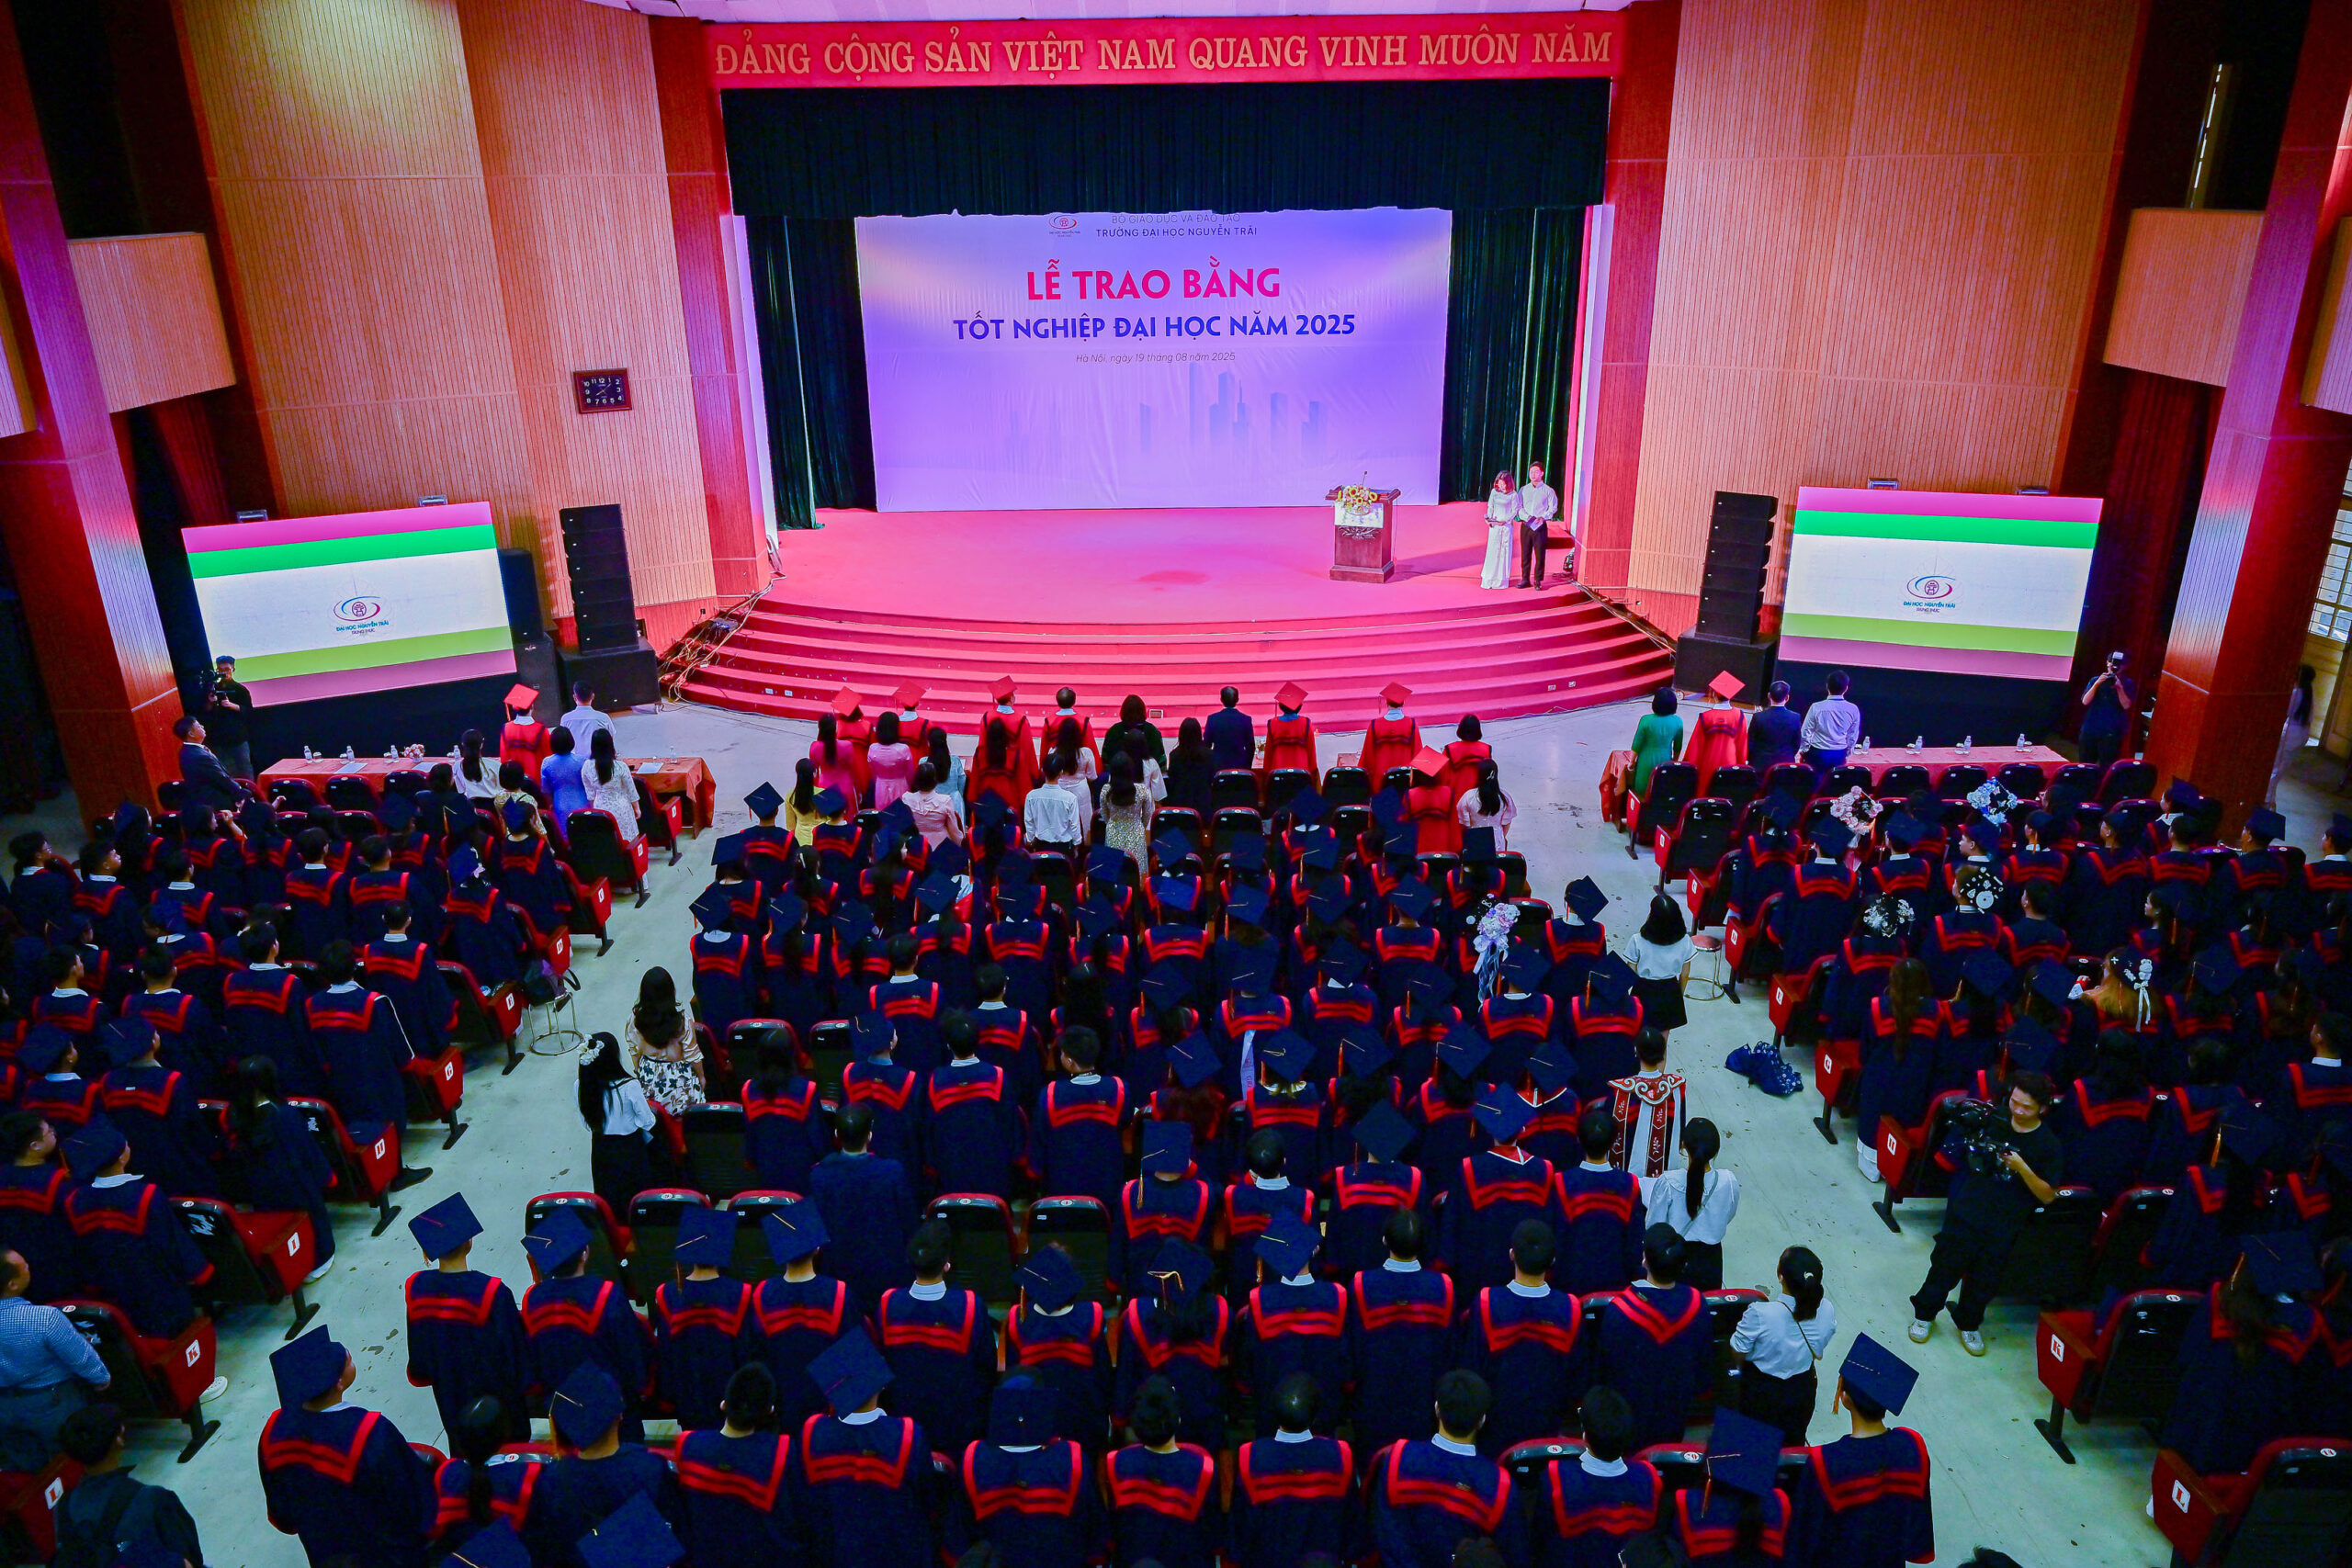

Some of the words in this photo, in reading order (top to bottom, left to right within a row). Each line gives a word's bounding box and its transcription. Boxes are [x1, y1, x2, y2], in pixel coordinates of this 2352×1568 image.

[716, 28, 811, 74] ĐẢNG
[824, 32, 915, 81] CỘNG
[925, 26, 991, 72] SẢN
[1002, 30, 1084, 79] VIỆT
[1098, 38, 1175, 70] NAM
[1189, 35, 1308, 71] QUANG
[1317, 35, 1408, 67] VINH
[1418, 24, 1519, 65] MUÔN
[1532, 23, 1612, 63] NĂM
[1096, 226, 1139, 238] TRƯỜNG
[1142, 228, 1159, 239] ĐẠI
[1163, 228, 1186, 239] HỌC
[1188, 223, 1231, 237] NGUYỄN
[1234, 224, 1257, 236] TRÃI
[1027, 258, 1061, 300] LỄ
[1072, 269, 1170, 299] TRAO
[1183, 255, 1280, 299] BẰNG
[953, 310, 1004, 340] TỐT
[1013, 312, 1105, 342] NGHIỆP
[1114, 316, 1156, 341] ĐẠI
[1165, 316, 1221, 341] HỌC
[1230, 310, 1288, 336] NĂM
[1295, 314, 1355, 335] 2025
[1136, 353, 1145, 363] 19
[1175, 353, 1188, 362] 08
[1212, 352, 1236, 362] 2025
